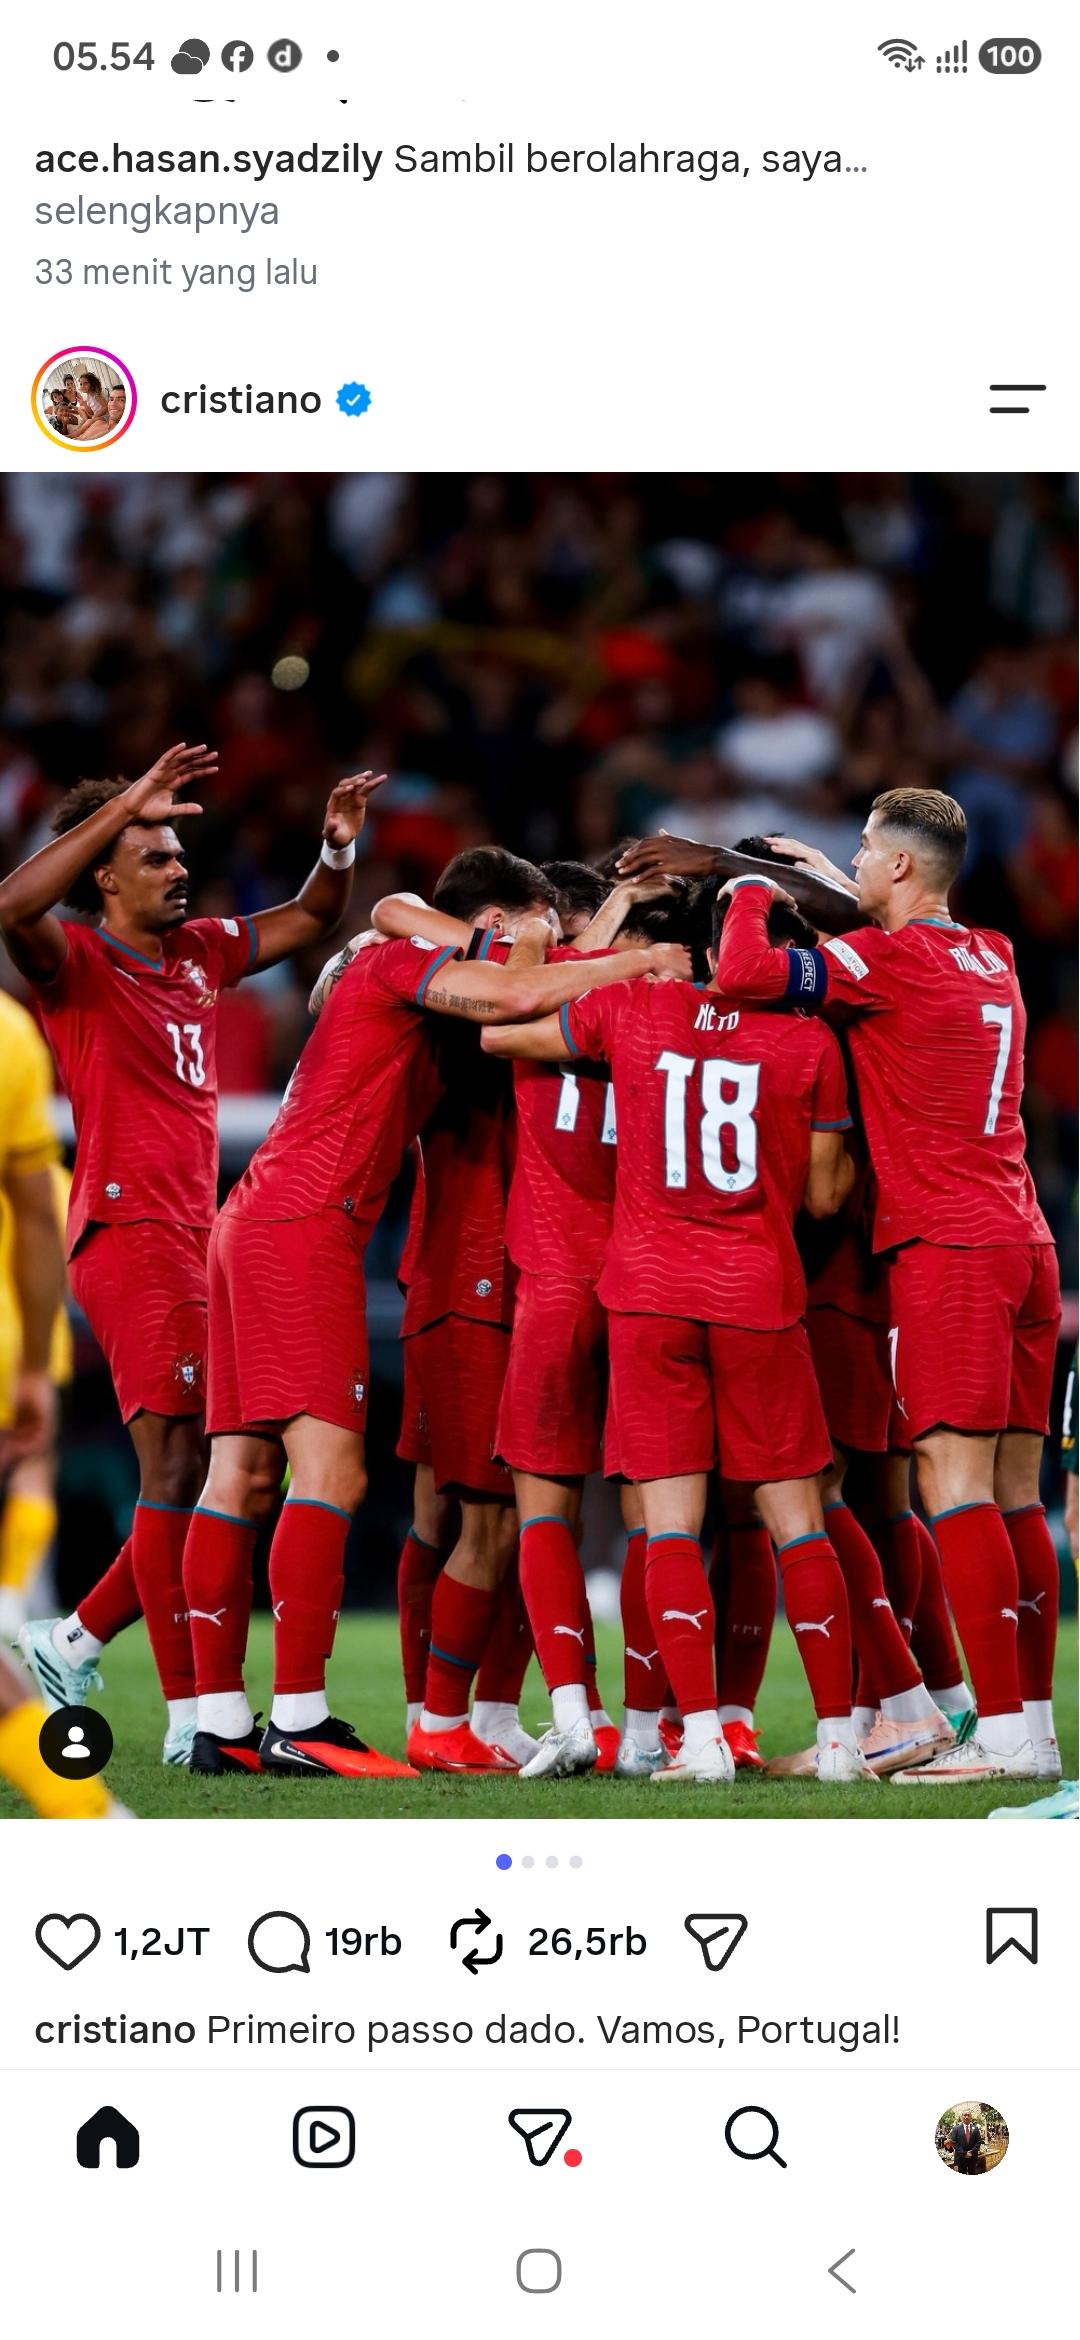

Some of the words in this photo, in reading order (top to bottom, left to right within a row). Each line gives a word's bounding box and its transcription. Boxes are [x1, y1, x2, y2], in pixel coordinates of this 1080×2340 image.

[54, 41, 155, 72] 05.54
[986, 44, 1035, 68] 100
[36, 142, 383, 182] ace.hasan.syadzily
[395, 142, 513, 173] Sambil
[528, 142, 750, 182] berolahraga,
[35, 195, 279, 234] selengkapnya
[36, 258, 73, 285] 33
[84, 257, 172, 285] menit
[181, 264, 255, 293] yang
[266, 257, 317, 285] lalu
[160, 384, 322, 414] cristiano
[800, 948, 814, 993] RESPECT
[693, 1003, 740, 1031] NETO
[166, 1022, 207, 1087] 13
[980, 1002, 1013, 1135] 7
[653, 1049, 762, 1194] 18
[114, 1926, 211, 1961] 1,2JT
[325, 1926, 402, 1956] 19rb
[528, 1926, 647, 1961] 26,5rb
[35, 2013, 196, 2044] cristiano
[208, 2013, 356, 2044] Primeiro
[369, 2021, 474, 2053] passo
[485, 2013, 585, 2044] dado.
[597, 2015, 725, 2049] Vamos,
[738, 2013, 900, 2053] Portugal!
